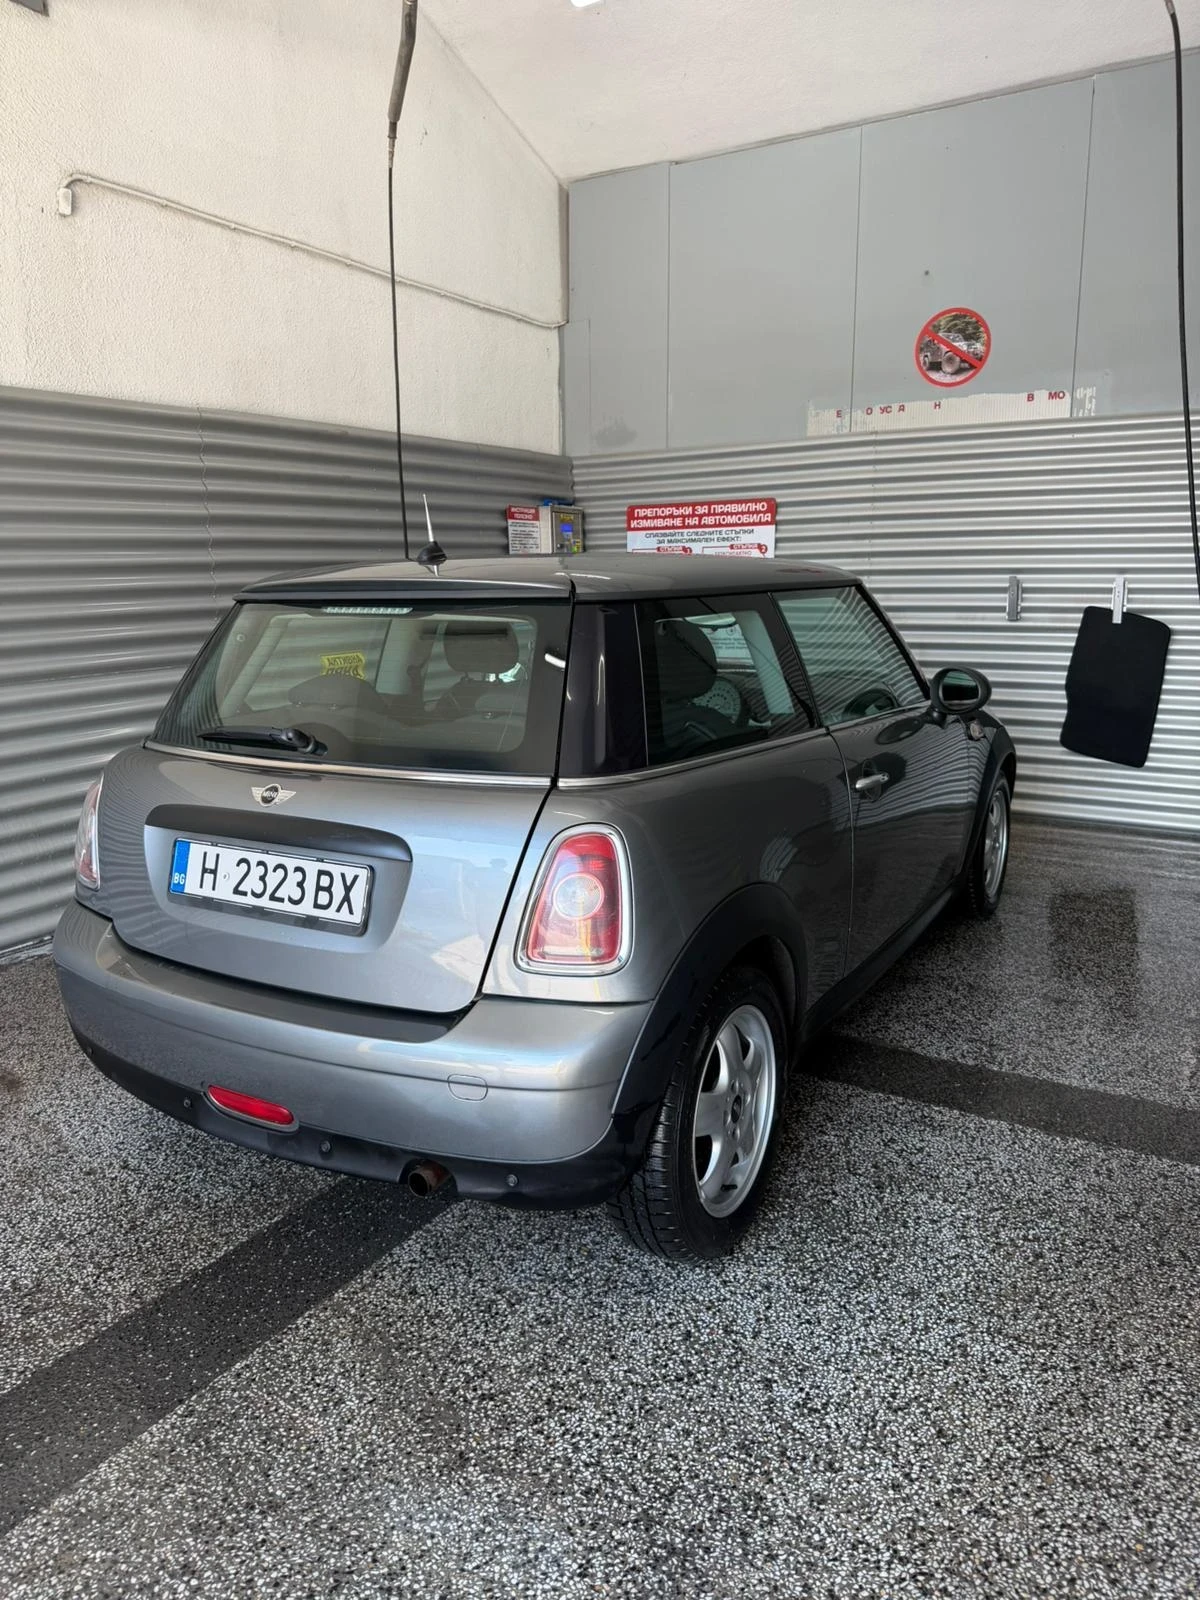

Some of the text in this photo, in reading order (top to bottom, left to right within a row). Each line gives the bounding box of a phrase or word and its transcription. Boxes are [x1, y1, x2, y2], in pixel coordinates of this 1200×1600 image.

[634, 502, 767, 517] ПРЕПОРЪКИ ЗА ПРАВИЛНО
[631, 513, 771, 528] ИЗМИВАНЕ НА АВТОМОБИЛА
[173, 872, 186, 885] BG
[199, 851, 220, 891] H
[232, 858, 307, 906] 2323
